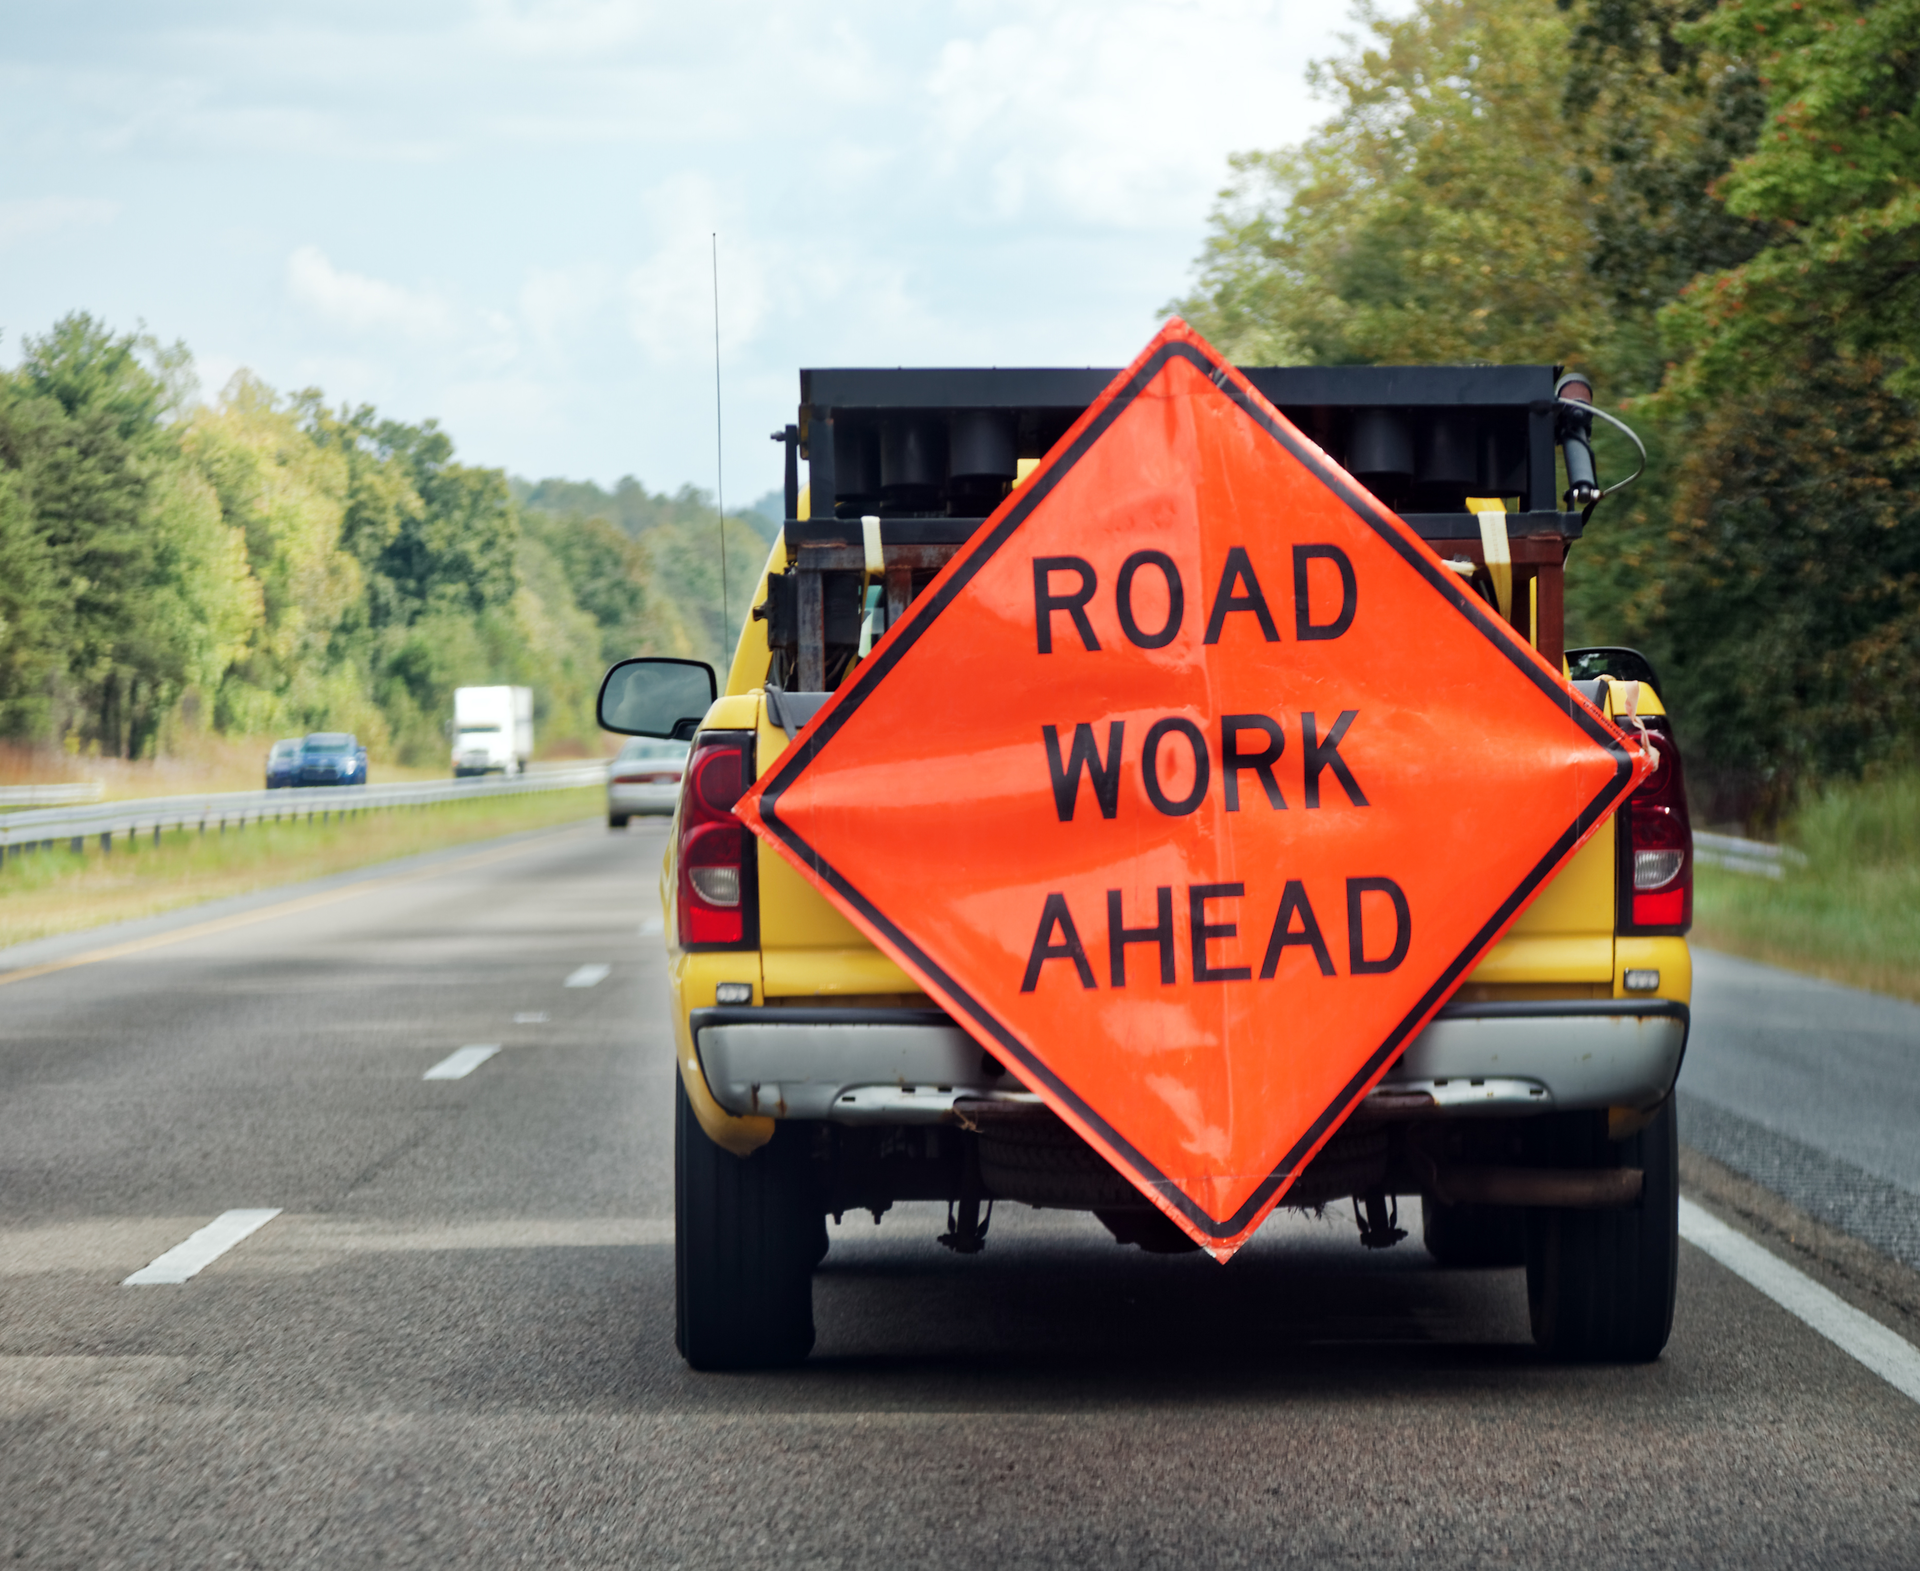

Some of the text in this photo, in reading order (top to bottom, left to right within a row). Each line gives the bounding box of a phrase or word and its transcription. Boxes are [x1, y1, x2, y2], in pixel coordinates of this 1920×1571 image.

[1033, 544, 1358, 654] ROAD
[1042, 711, 1369, 822] WORK
[1021, 877, 1412, 992] AHEAD
